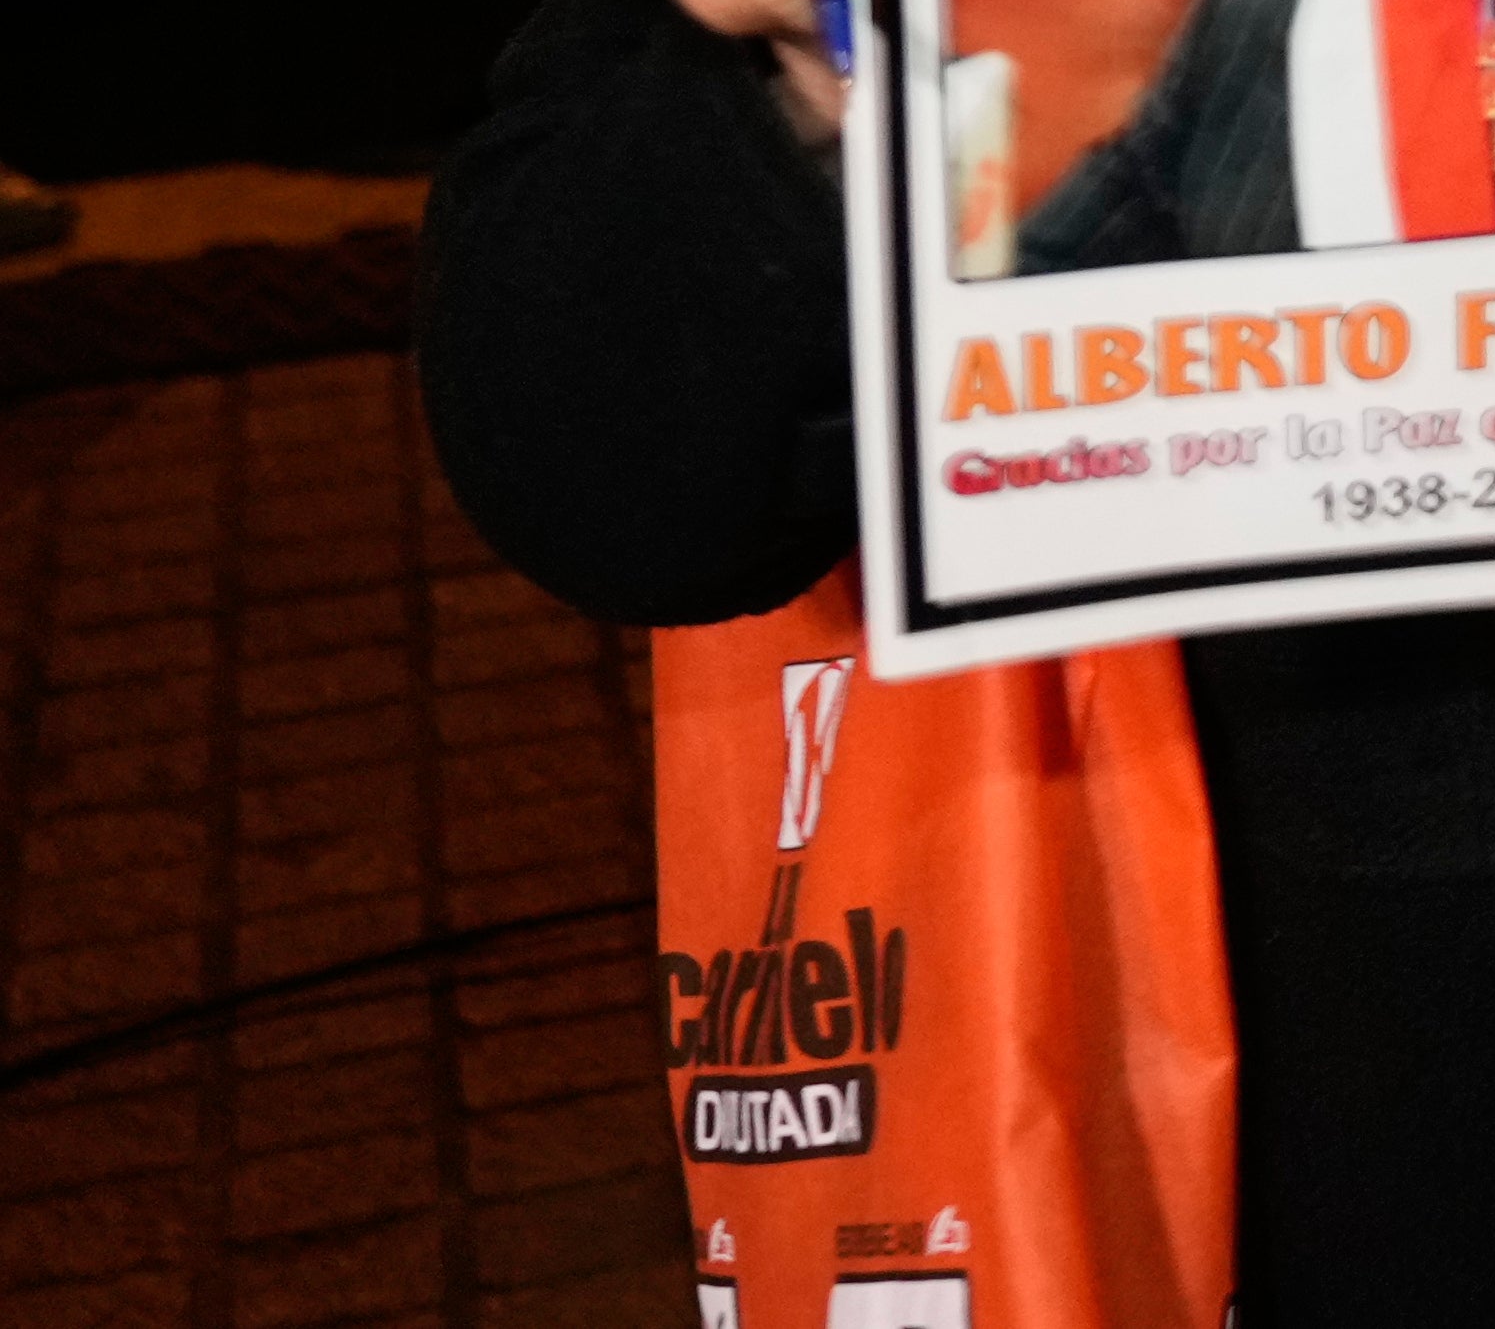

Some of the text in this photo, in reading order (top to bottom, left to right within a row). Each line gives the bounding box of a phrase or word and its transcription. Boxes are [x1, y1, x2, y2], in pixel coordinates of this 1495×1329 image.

[942, 301, 1411, 422] ALBERTO
[942, 437, 1151, 496] Gracias
[1168, 423, 1267, 476] por
[1284, 413, 1342, 461] la
[1361, 405, 1463, 453] Paz
